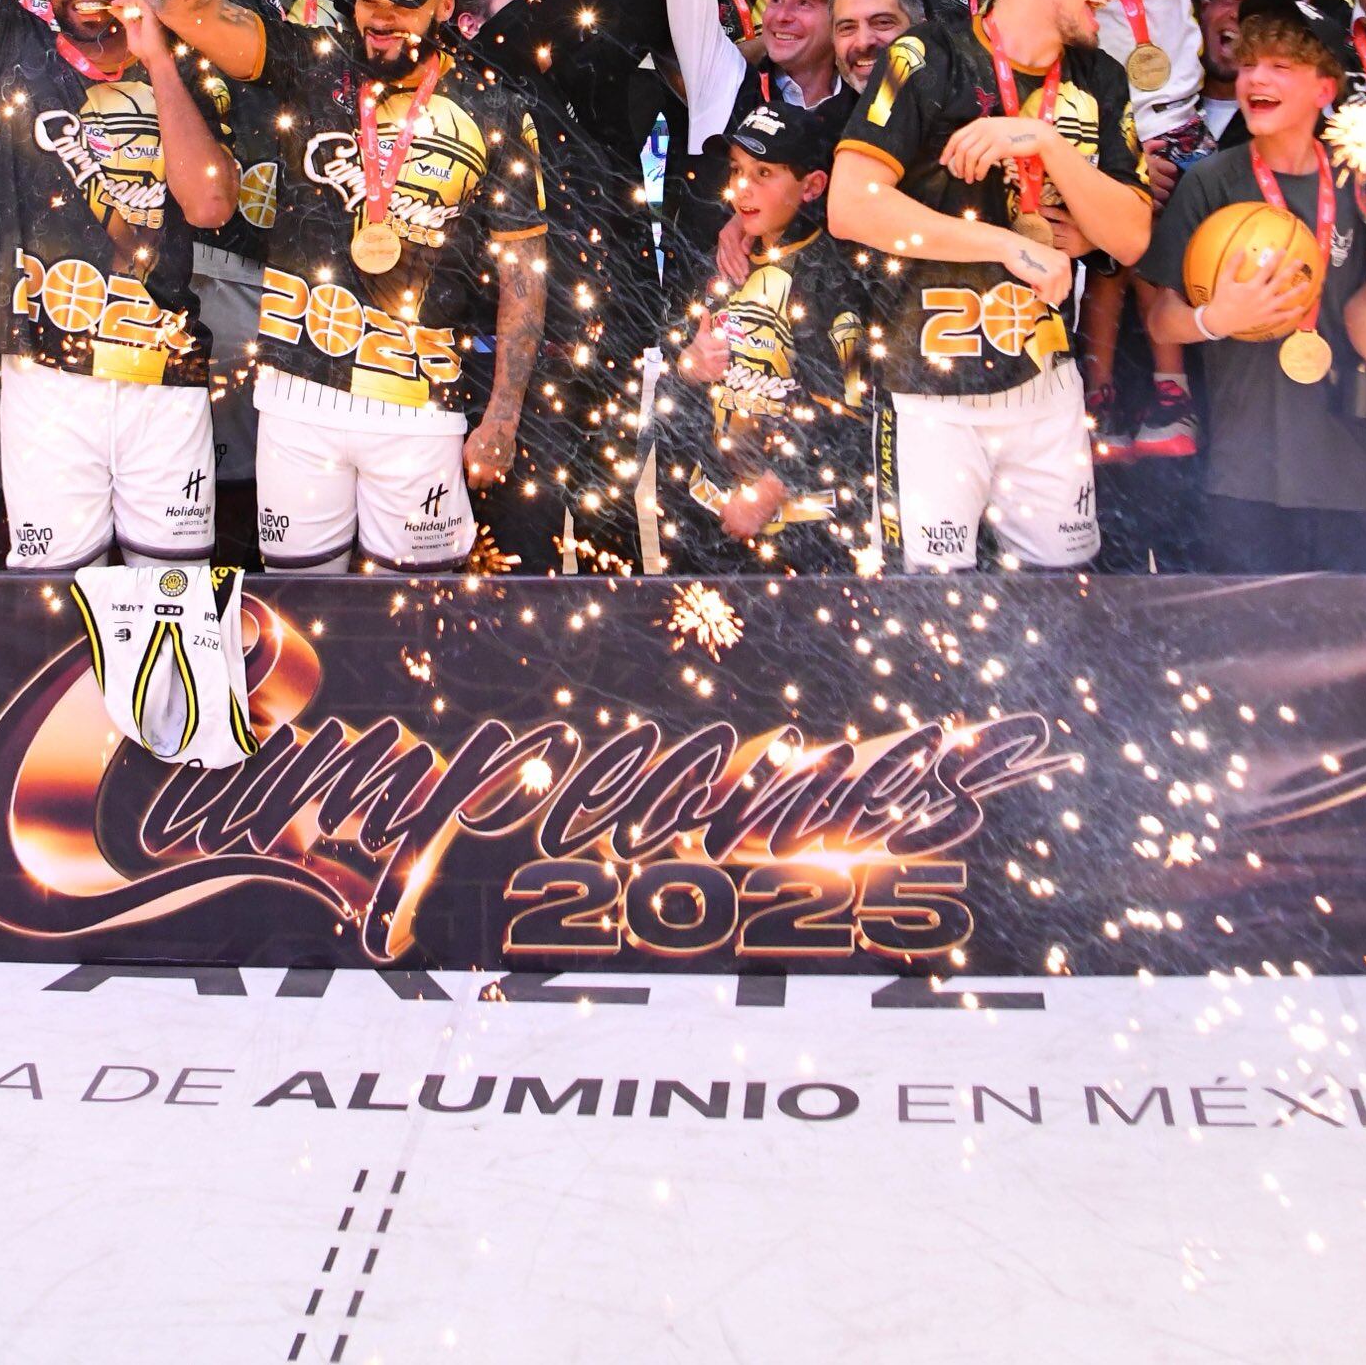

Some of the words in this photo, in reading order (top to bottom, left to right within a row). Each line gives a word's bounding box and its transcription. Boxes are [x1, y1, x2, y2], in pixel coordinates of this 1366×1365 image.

[165, 505, 205, 519] Holiday
[403, 518, 447, 533] Holiday
[447, 515, 463, 528] Inn
[503, 862, 973, 956] 2025
[80, 1064, 237, 1107] DE
[253, 1070, 861, 1122] ALUMINIO
[897, 1083, 1040, 1125] EN
